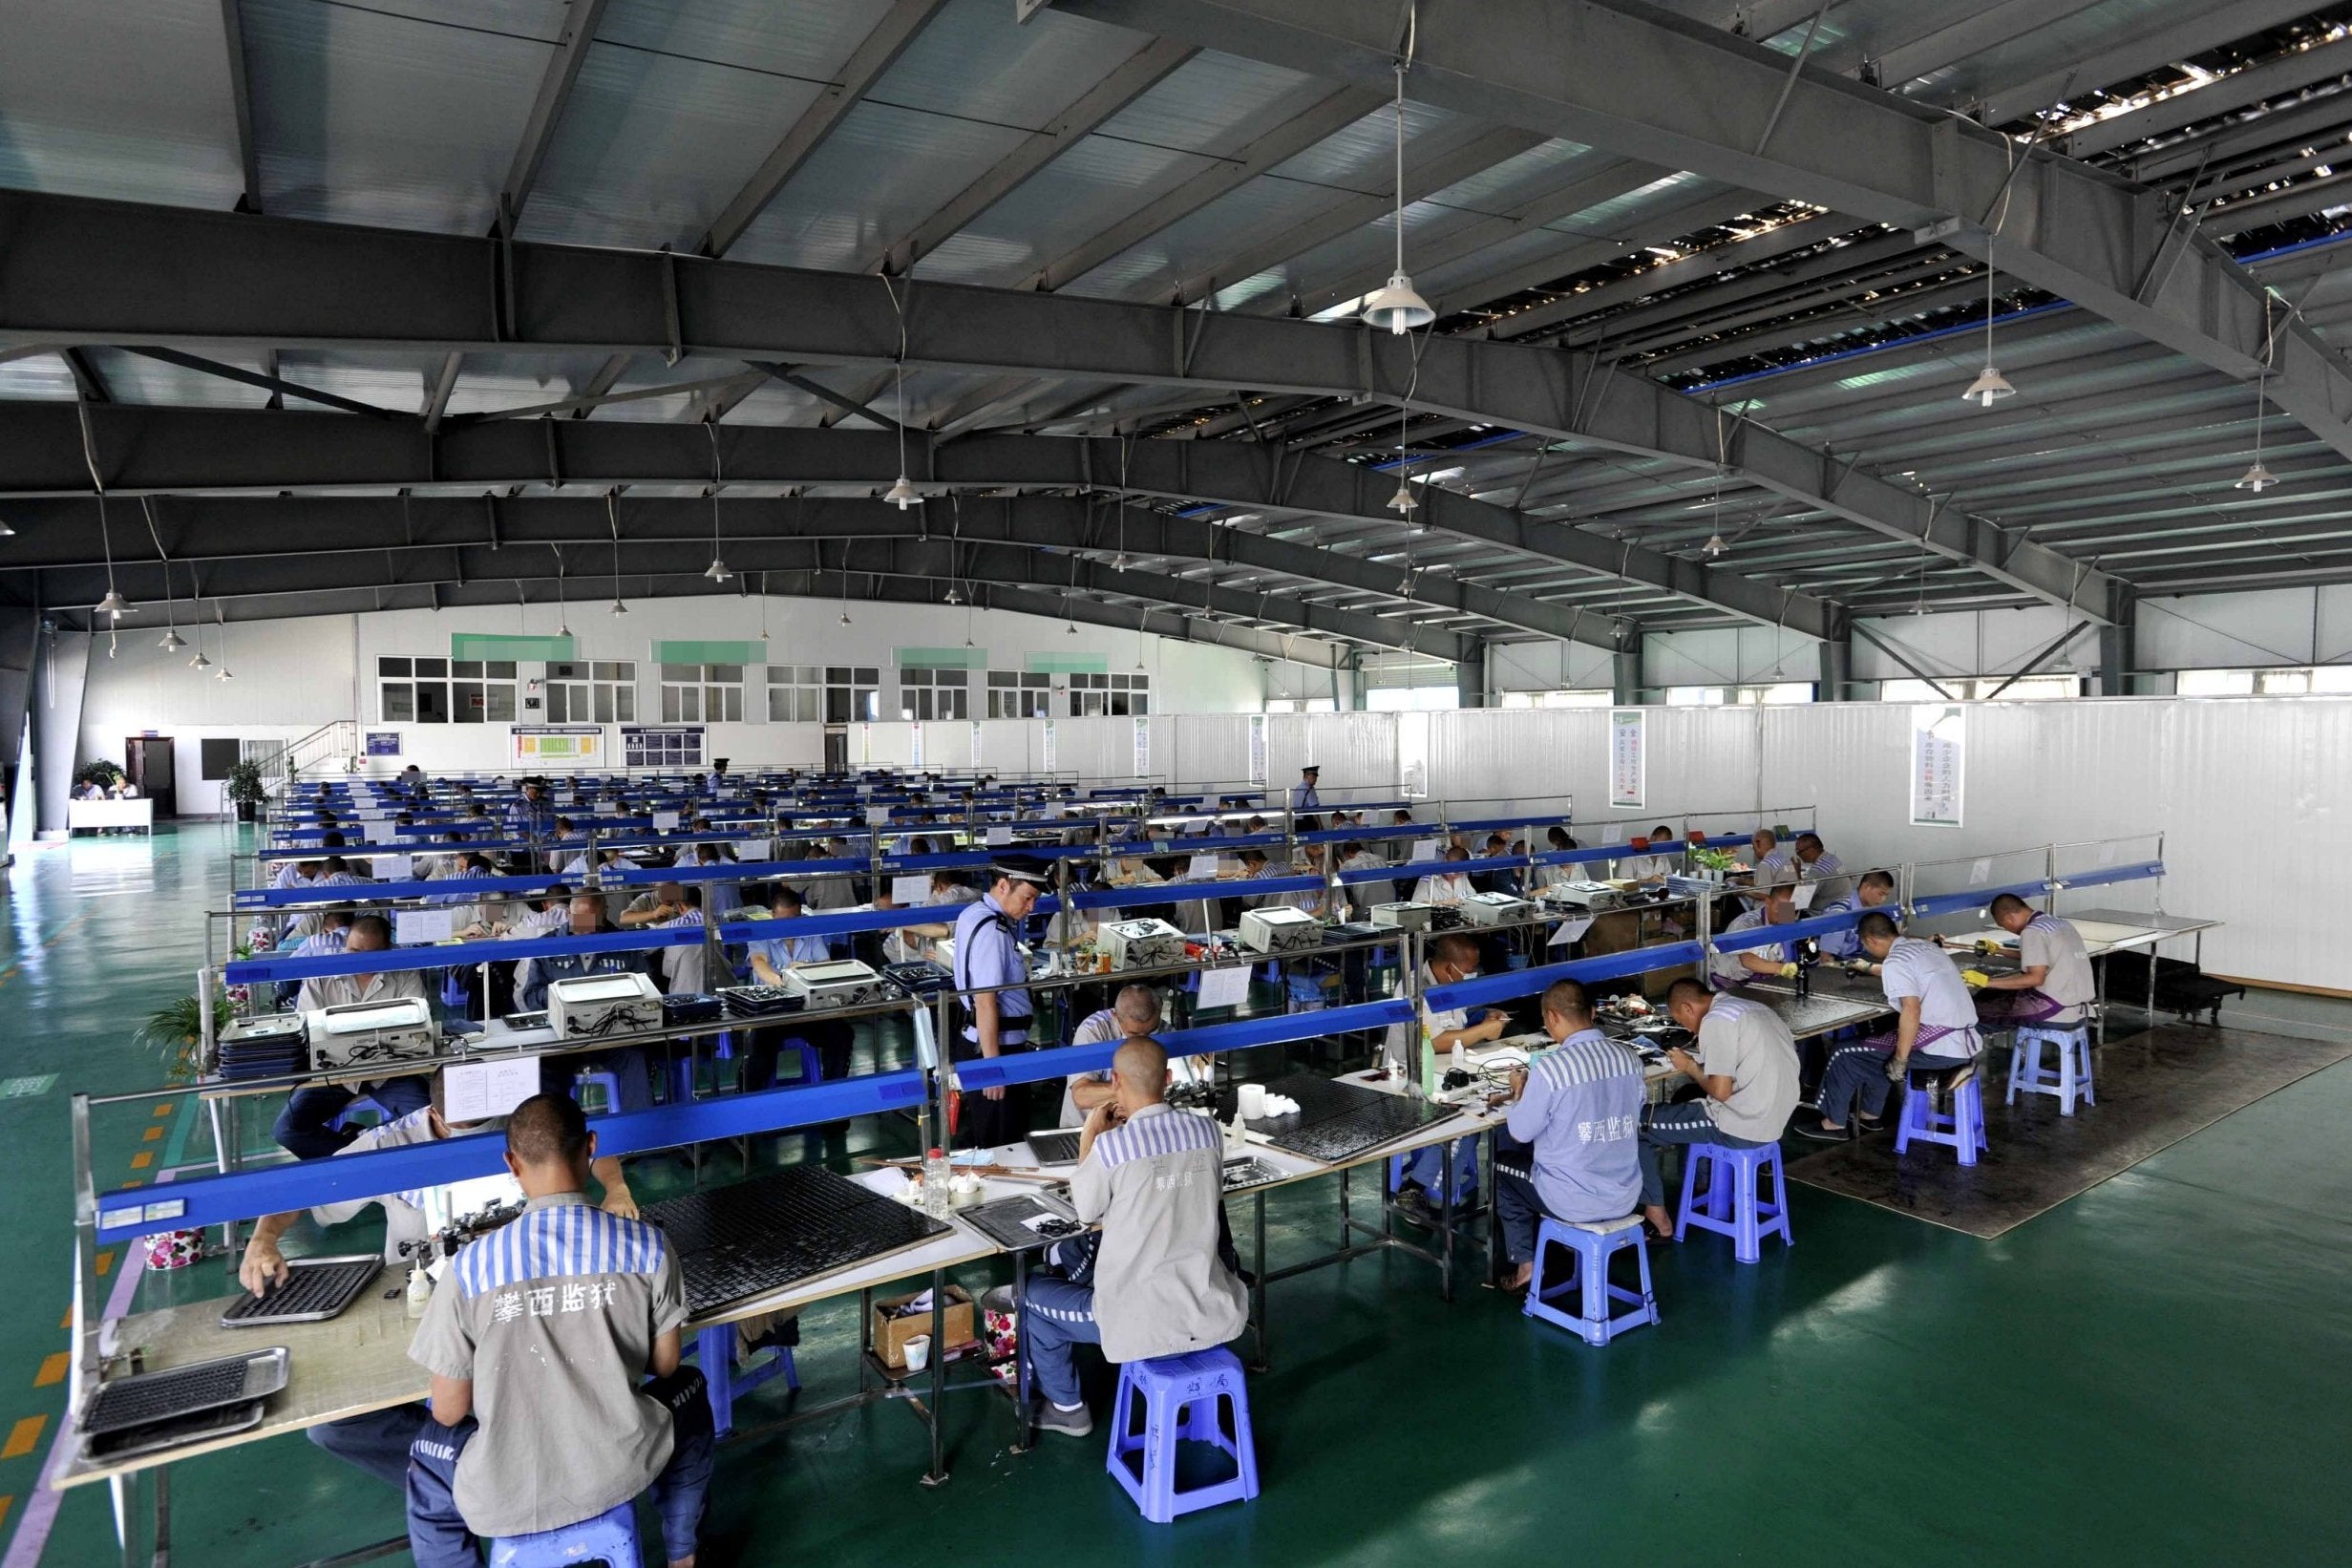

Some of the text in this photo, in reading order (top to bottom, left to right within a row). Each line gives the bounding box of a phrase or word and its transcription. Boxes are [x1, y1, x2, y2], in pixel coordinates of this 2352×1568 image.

[1578, 1113, 1634, 1145] 攀西监狱
[494, 1280, 616, 1323] 攀西监狱
